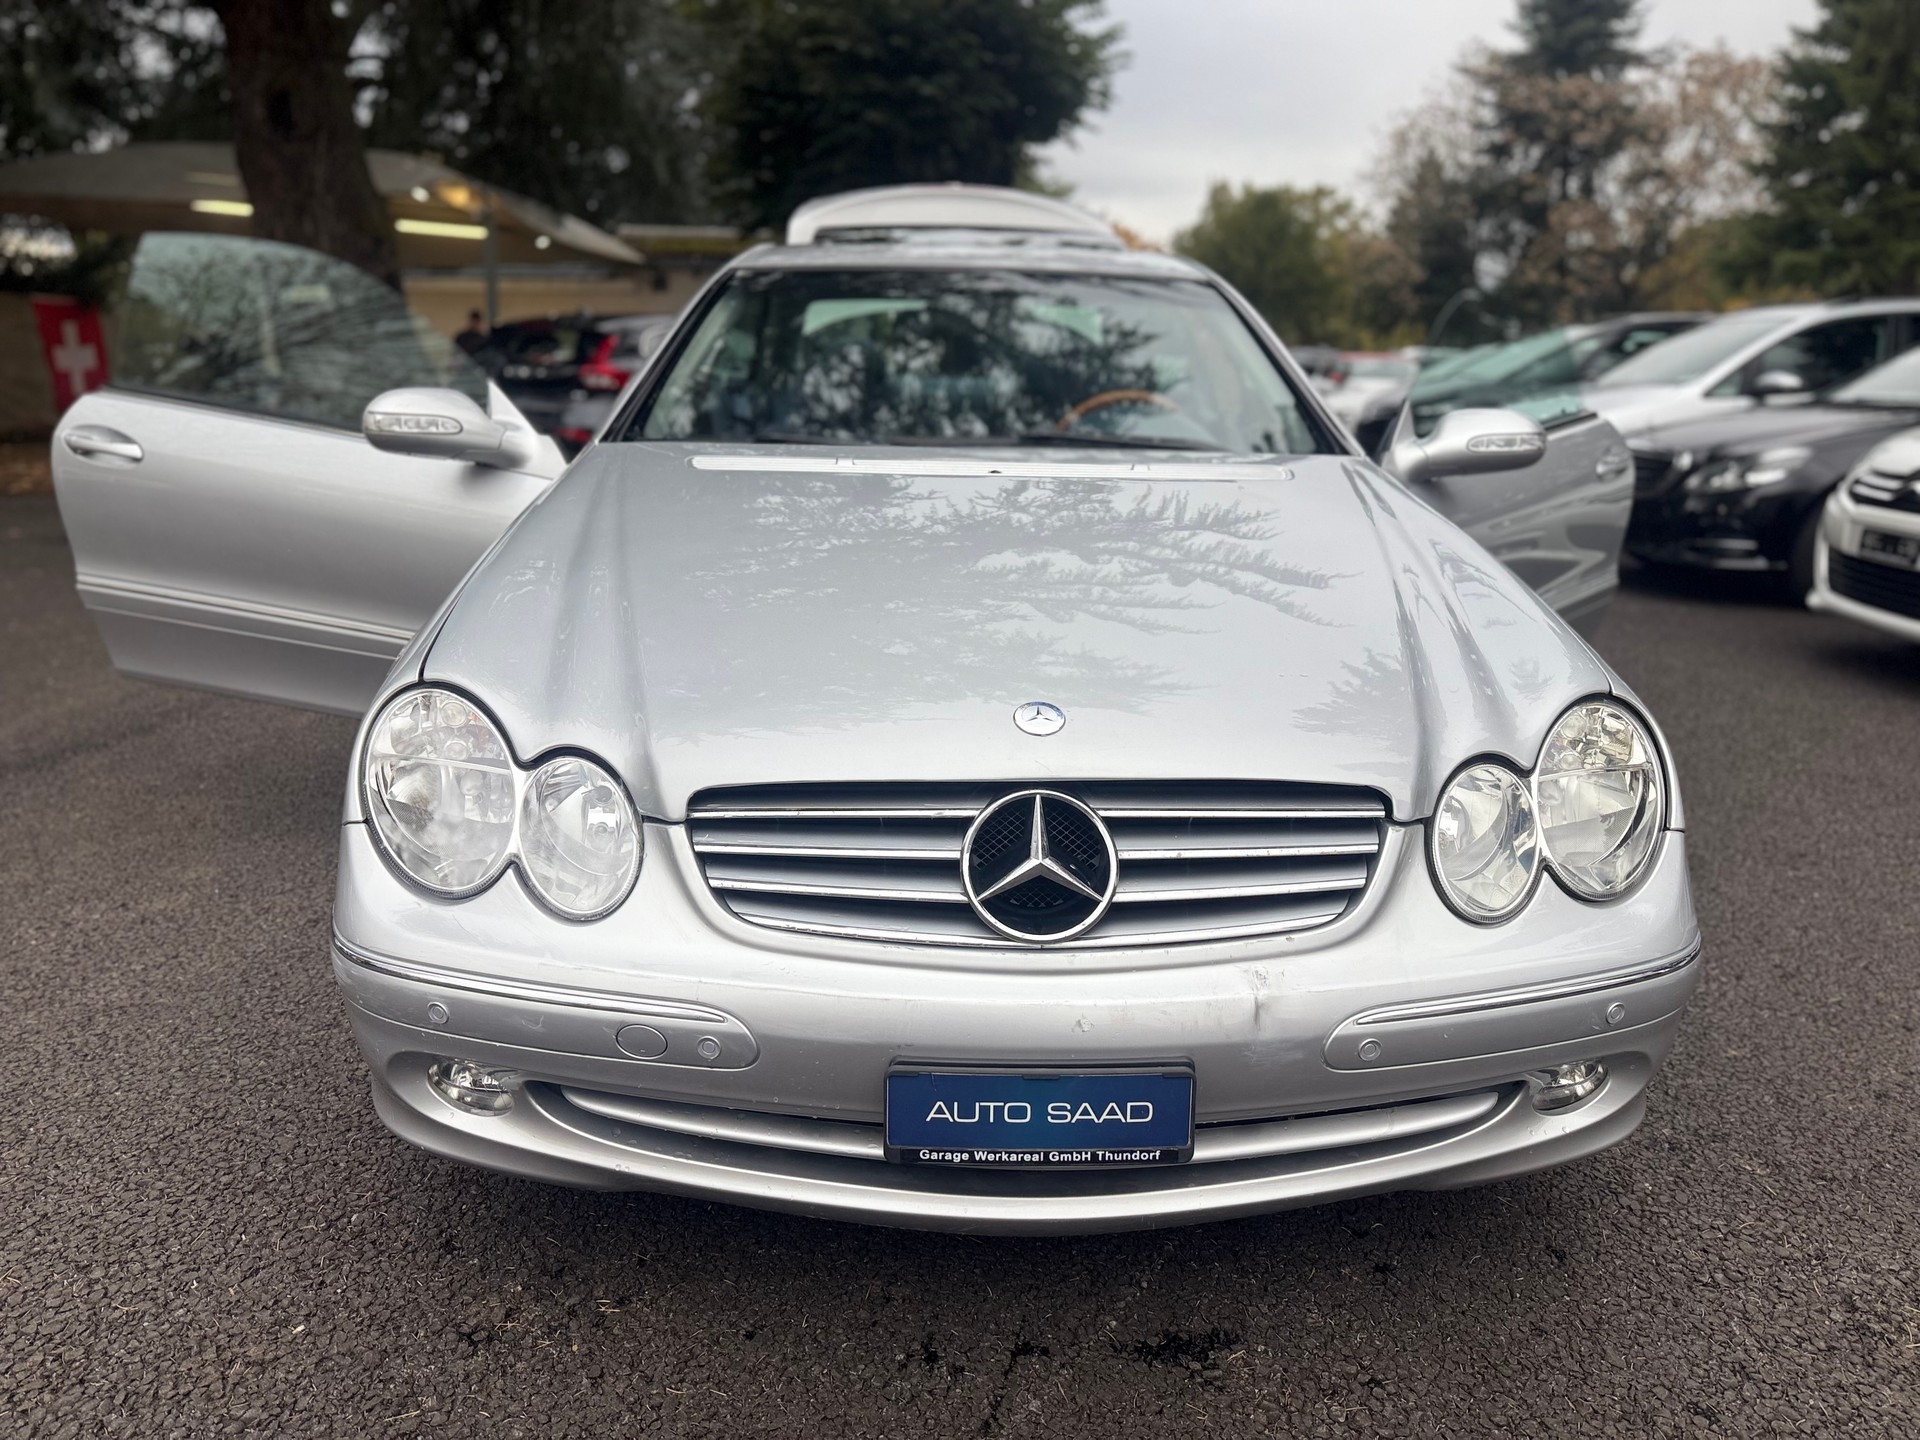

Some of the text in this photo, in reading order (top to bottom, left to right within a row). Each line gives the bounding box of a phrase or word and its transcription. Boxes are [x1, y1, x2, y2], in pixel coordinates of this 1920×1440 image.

[926, 1101, 1154, 1124] AUTO SAAD
[919, 1149, 1161, 1163] Garage Werkareal GmbH Thundorf
